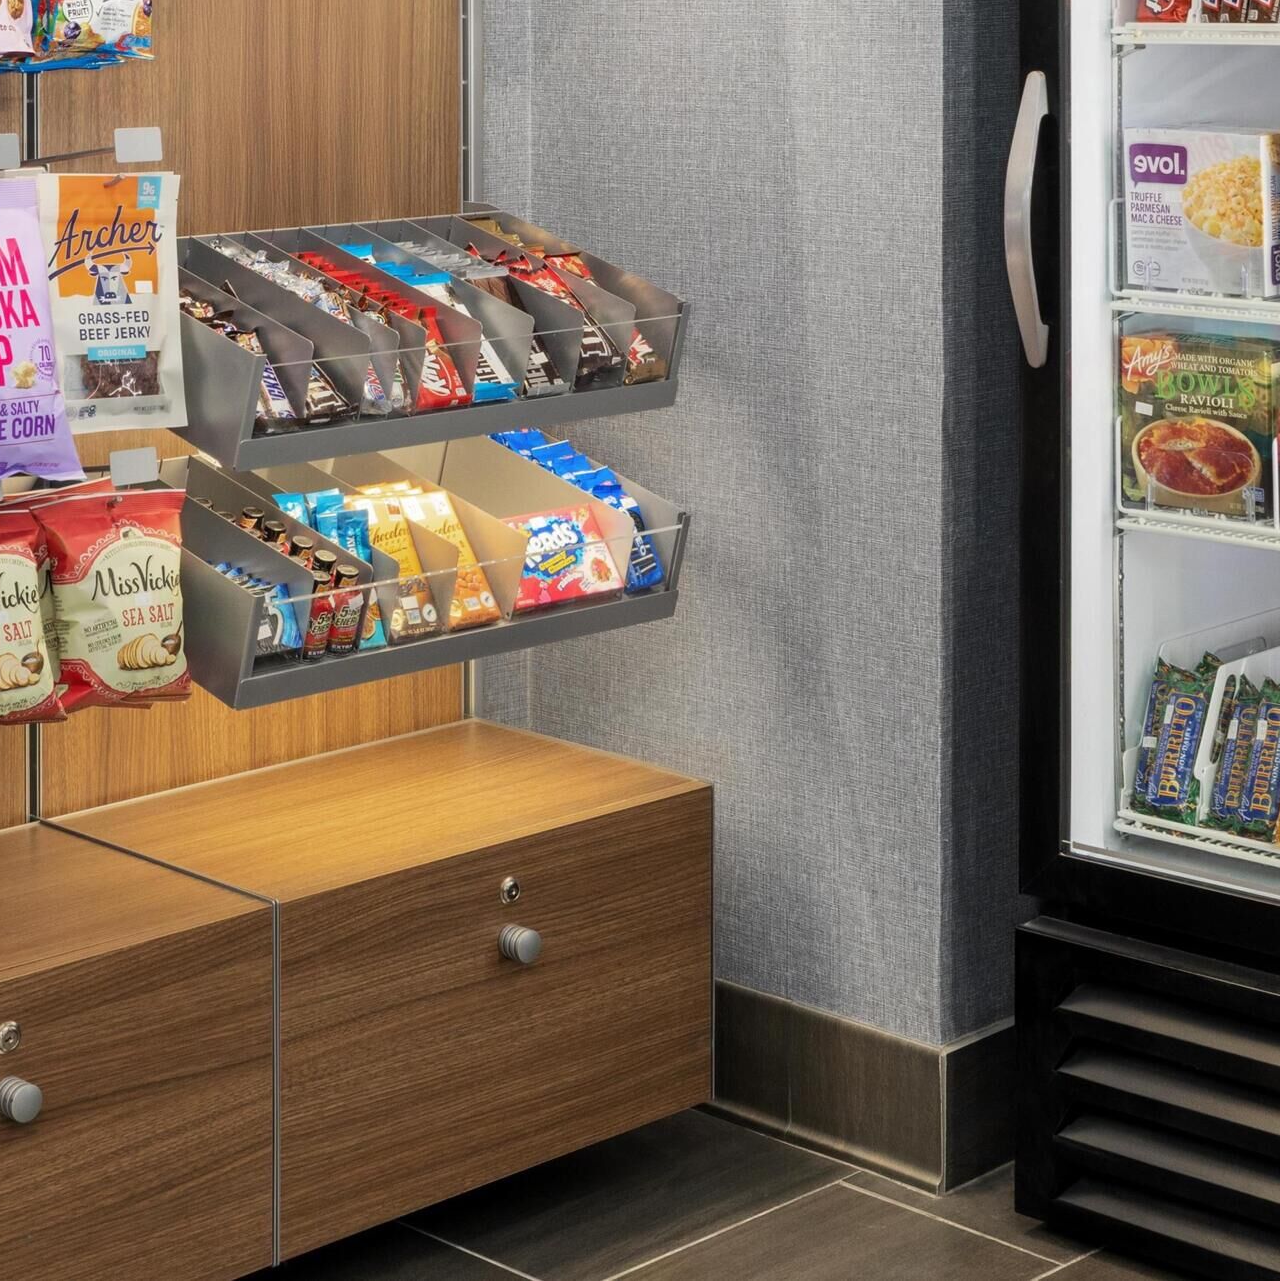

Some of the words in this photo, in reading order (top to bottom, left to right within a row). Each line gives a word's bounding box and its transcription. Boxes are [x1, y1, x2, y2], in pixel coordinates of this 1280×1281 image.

[67, 1, 87, 9] WHOLE
[1130, 192, 1162, 203] TRUFFLE
[1130, 202, 1170, 214] PARMESAN
[1131, 213, 1152, 224] MAC
[1154, 214, 1162, 224] &
[1164, 215, 1182, 225] CHEESE
[48, 207, 162, 267] Archer
[78, 311, 149, 324] GRASS-FED
[79, 327, 111, 340] BEEF
[115, 326, 150, 339] JERKY
[1124, 346, 1173, 381] Amy's
[1156, 371, 1255, 408] BOWLS
[1181, 394, 1233, 408] RAVIOLI
[0, 405, 7, 416] &
[10, 401, 40, 415] SALTY
[15, 415, 55, 436] CORN
[4, 621, 33, 641] SALT
[1157, 697, 1196, 799] BURRITO
